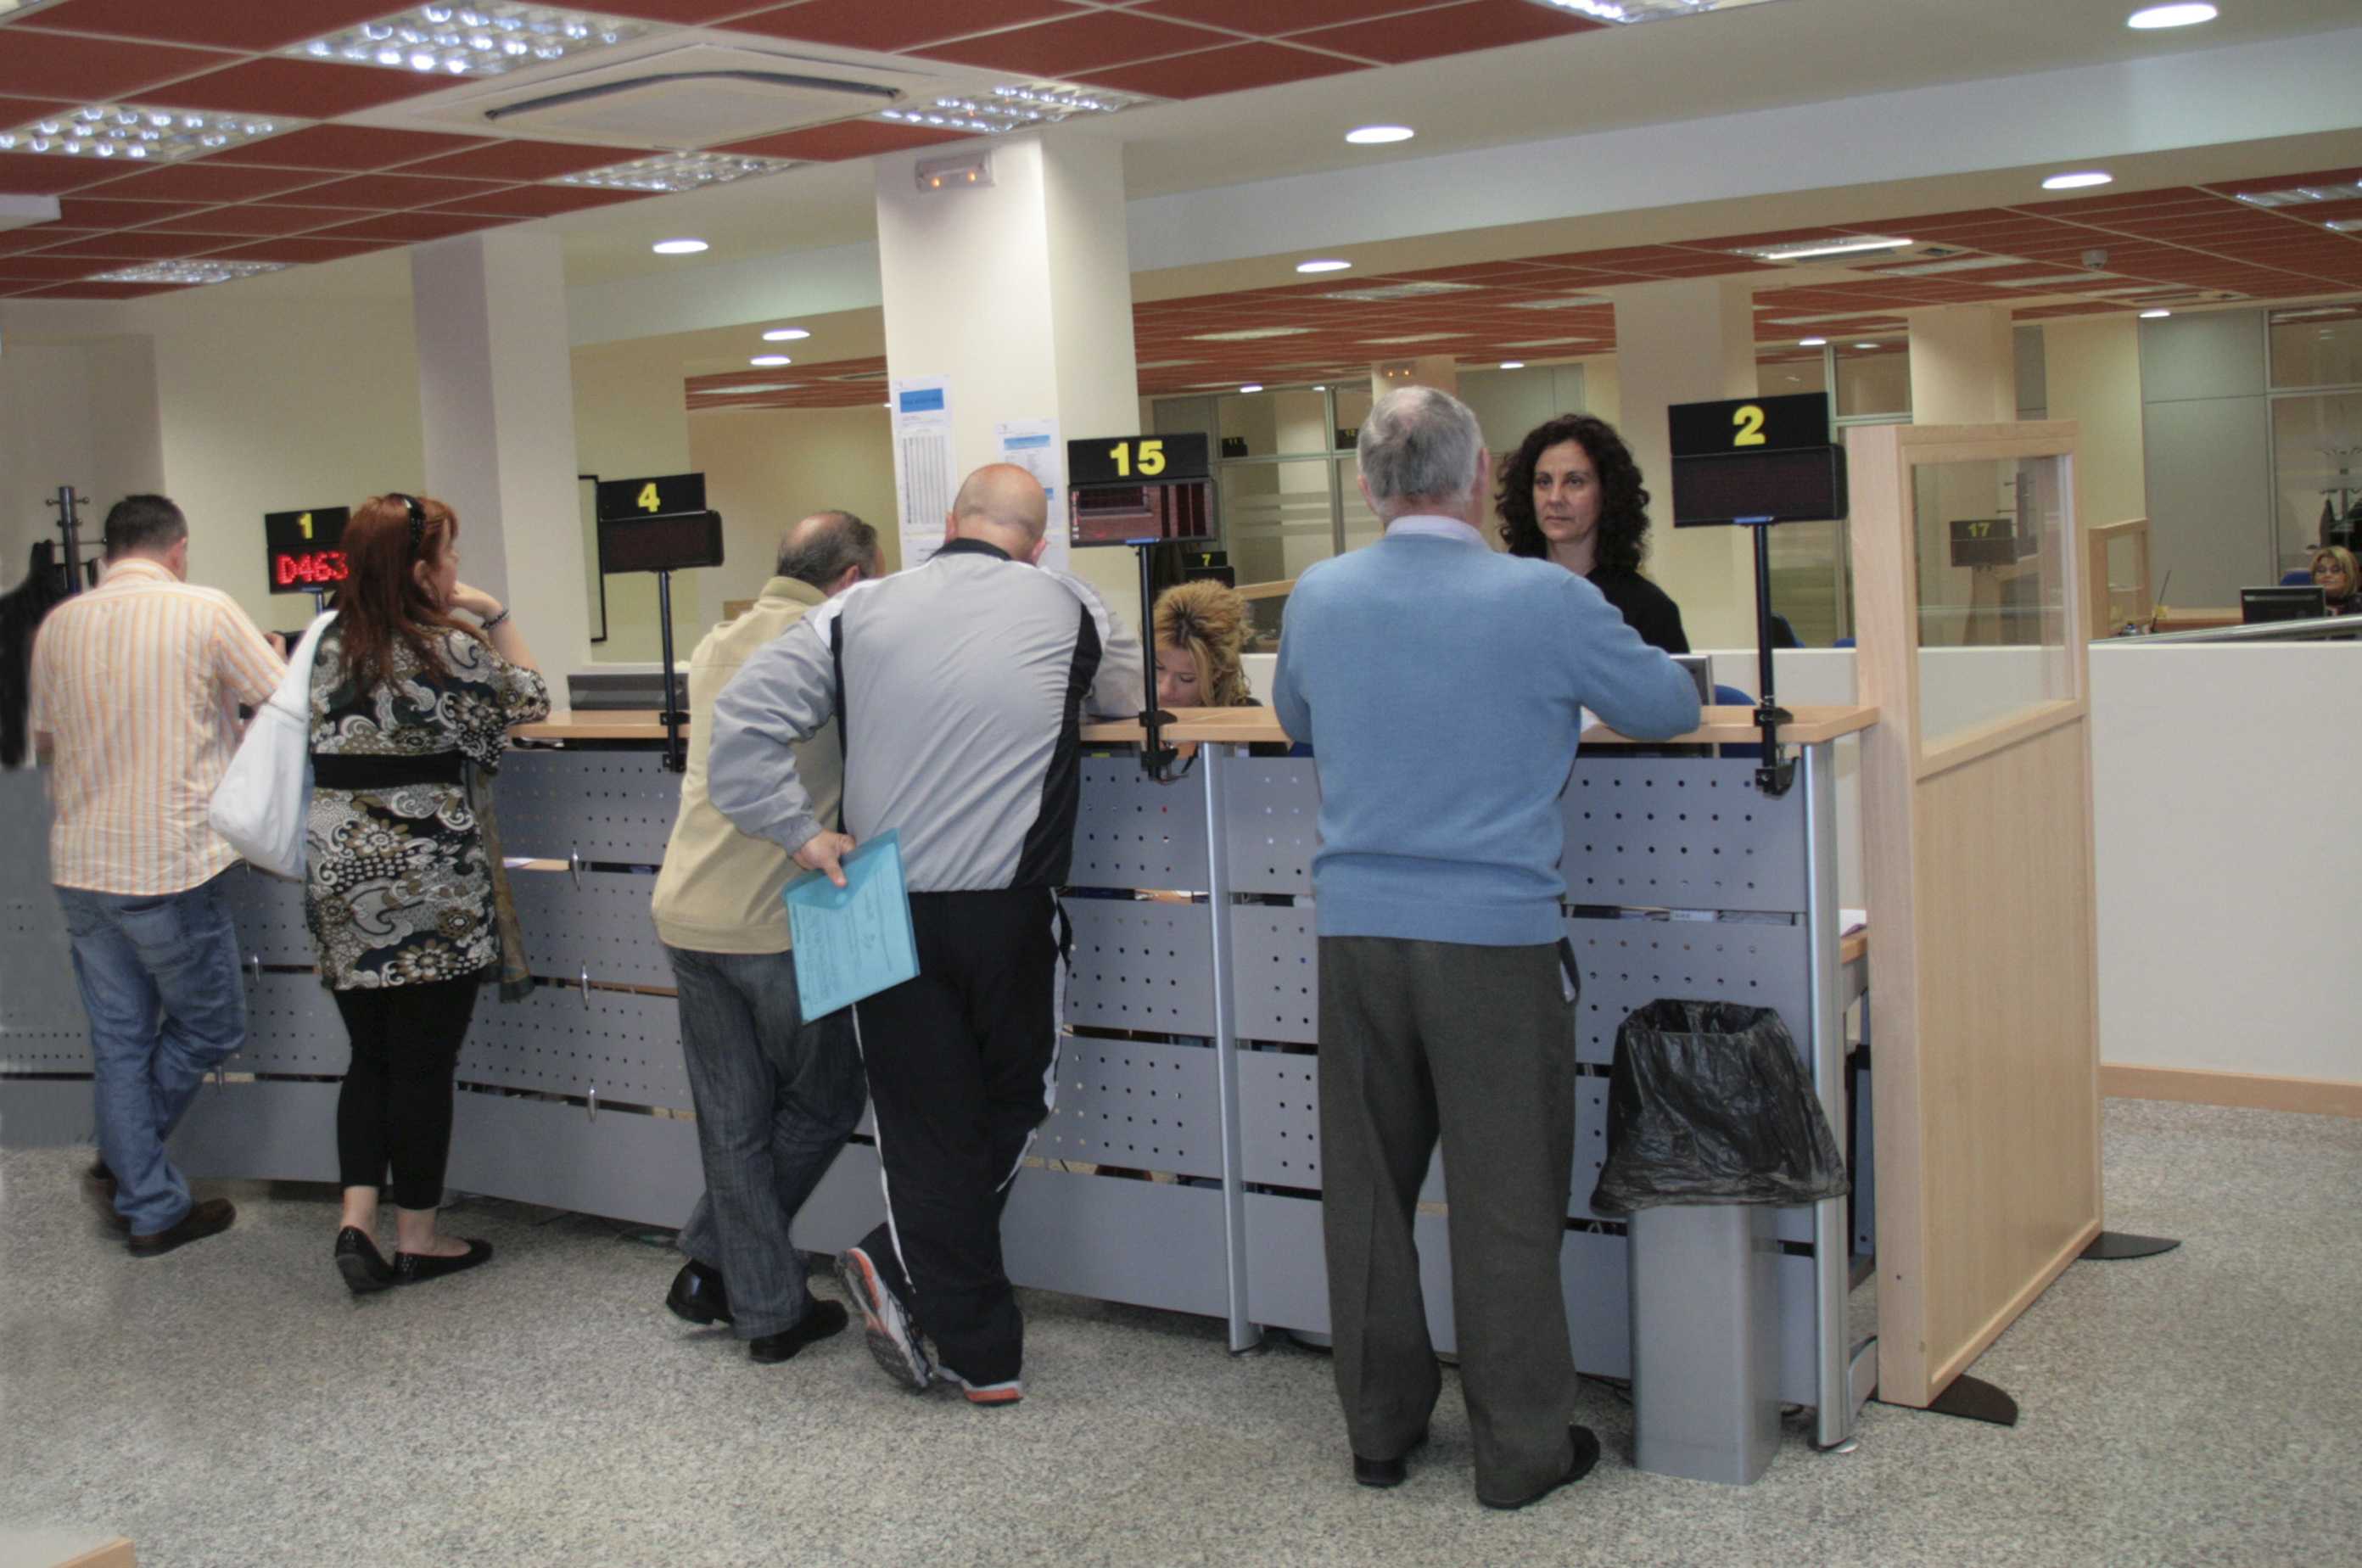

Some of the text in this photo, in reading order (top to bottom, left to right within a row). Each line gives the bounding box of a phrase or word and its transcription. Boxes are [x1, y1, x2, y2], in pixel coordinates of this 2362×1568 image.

[1732, 405, 1766, 446] 2
[1110, 440, 1166, 476] 15
[638, 482, 660, 512] 4
[299, 512, 313, 539] 1
[1969, 522, 1990, 537] 17
[277, 551, 349, 584] D463
[1201, 553, 1211, 567] 7
